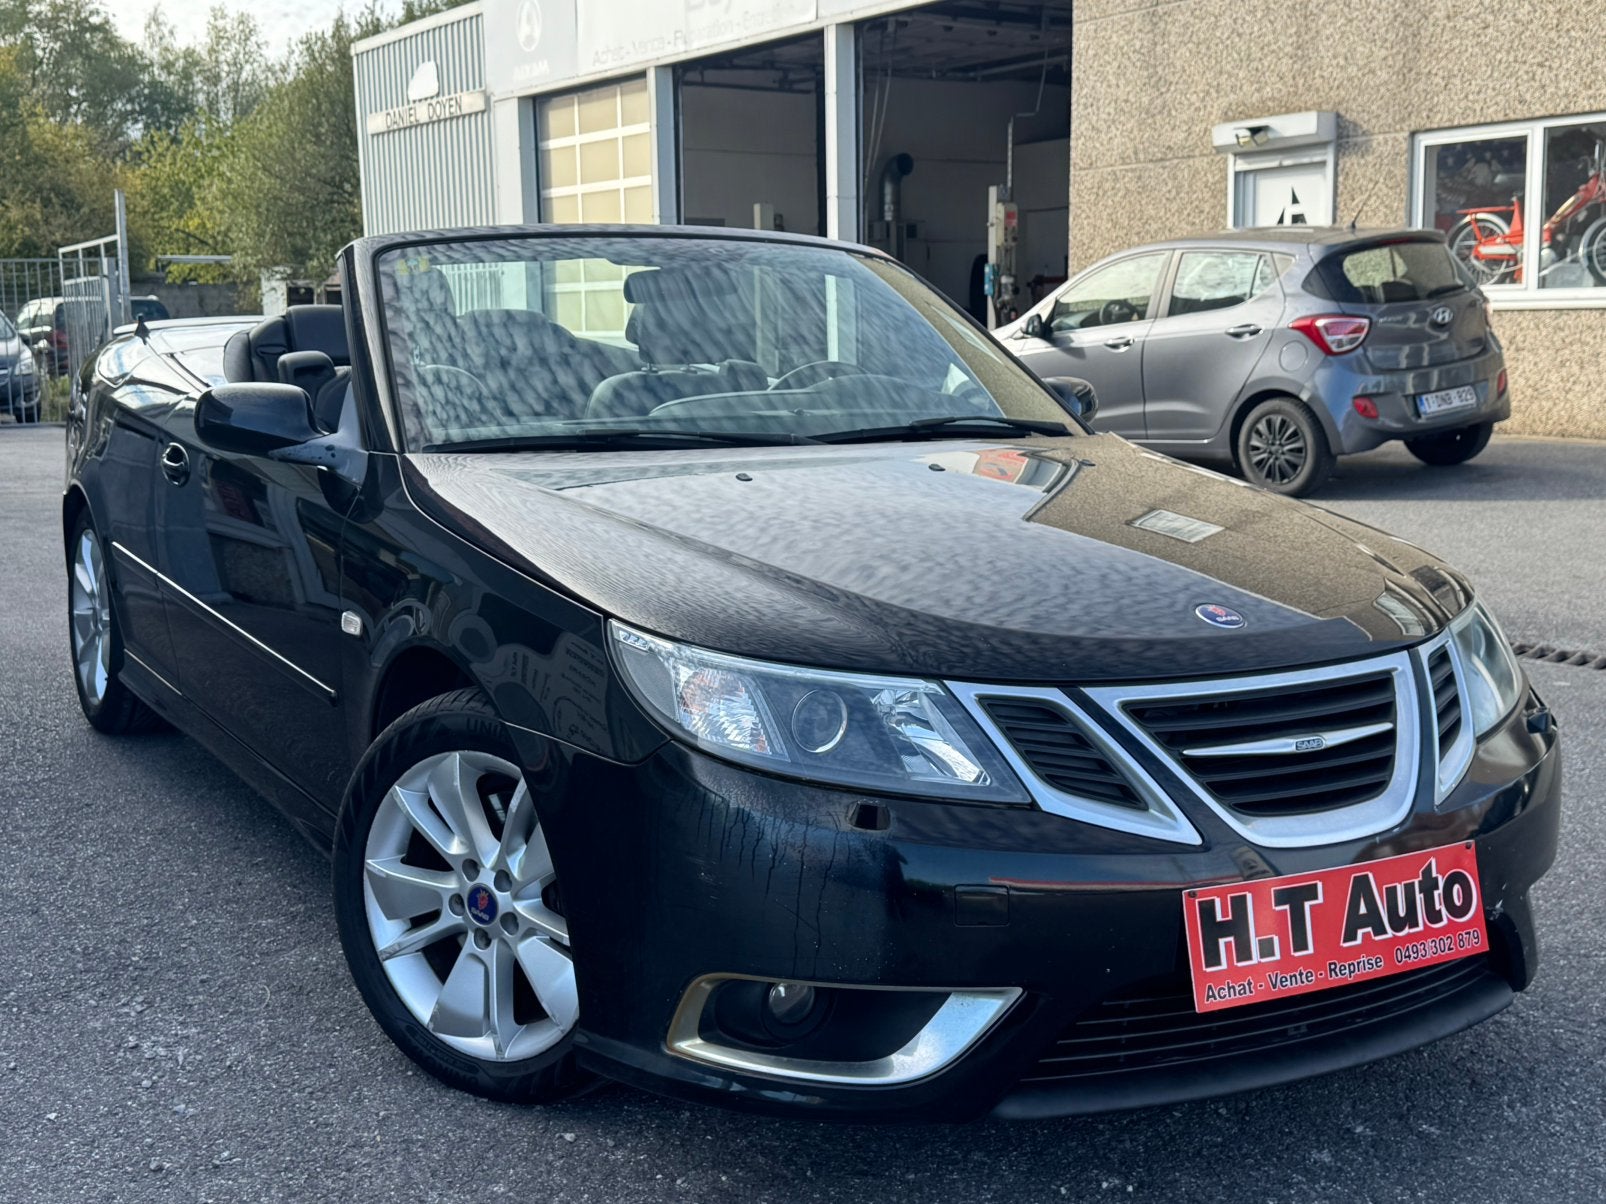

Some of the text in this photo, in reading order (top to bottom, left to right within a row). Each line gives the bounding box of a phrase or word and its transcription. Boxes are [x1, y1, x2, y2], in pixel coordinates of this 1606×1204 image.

[386, 95, 462, 128] DANIEL DOYEN
[1296, 739, 1323, 750] SAAB
[1340, 856, 1478, 947] Auto
[1204, 978, 1254, 1004] Achat
[1267, 967, 1314, 991] Vente
[1328, 954, 1384, 985] Reprise
[1394, 935, 1455, 965] 0493/302
[1457, 928, 1481, 950] 879
